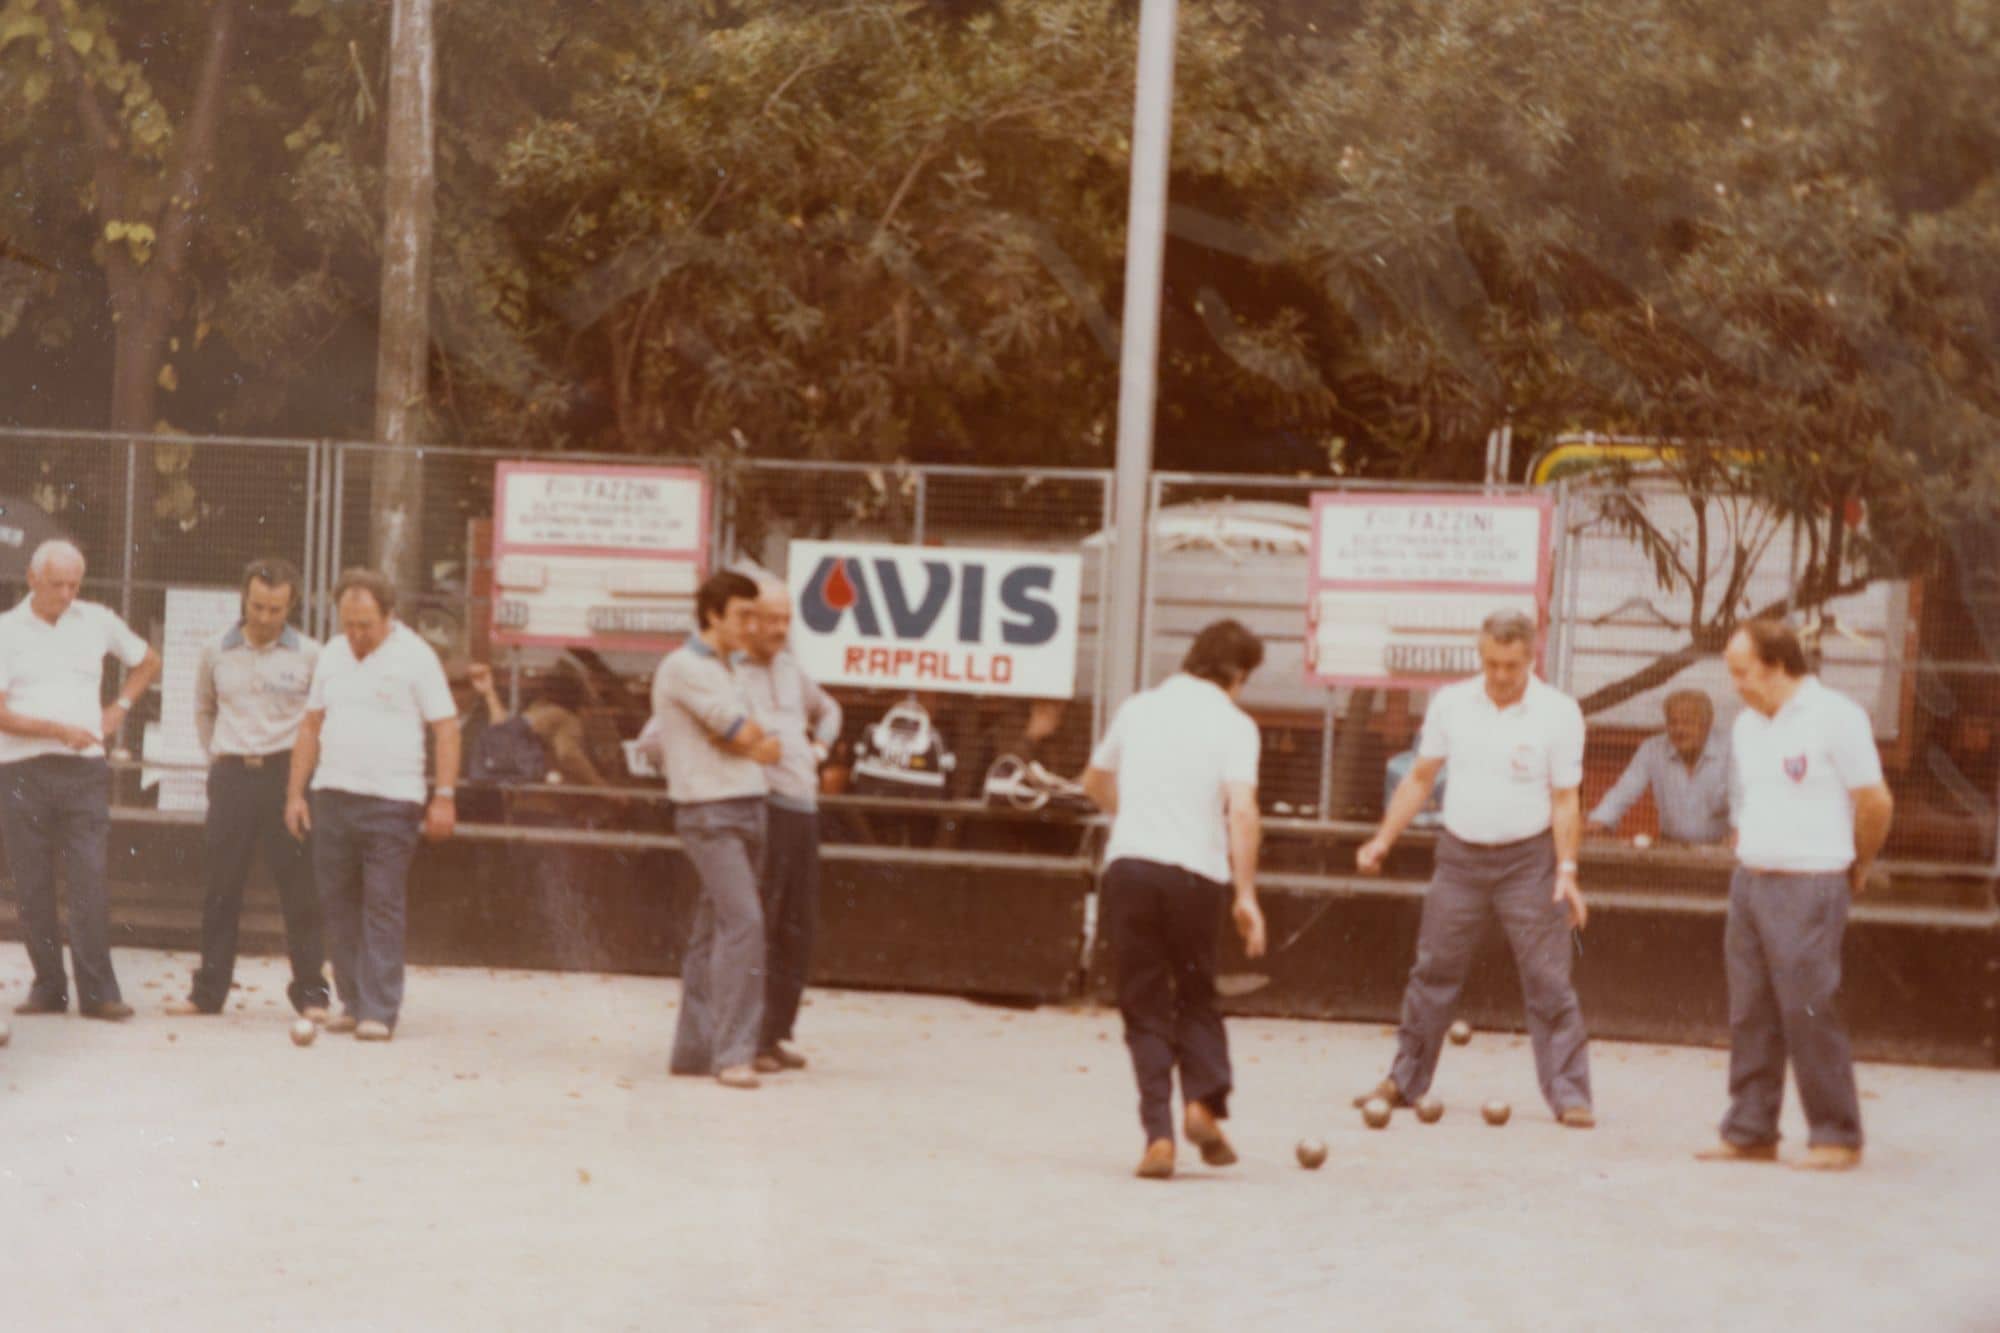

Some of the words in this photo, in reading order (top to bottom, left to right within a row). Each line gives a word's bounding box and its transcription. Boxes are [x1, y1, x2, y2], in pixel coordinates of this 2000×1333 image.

[1408, 510, 1495, 532] FAZZINI
[799, 556, 1060, 647] AVIS
[843, 646, 1014, 685] RAPALLO
